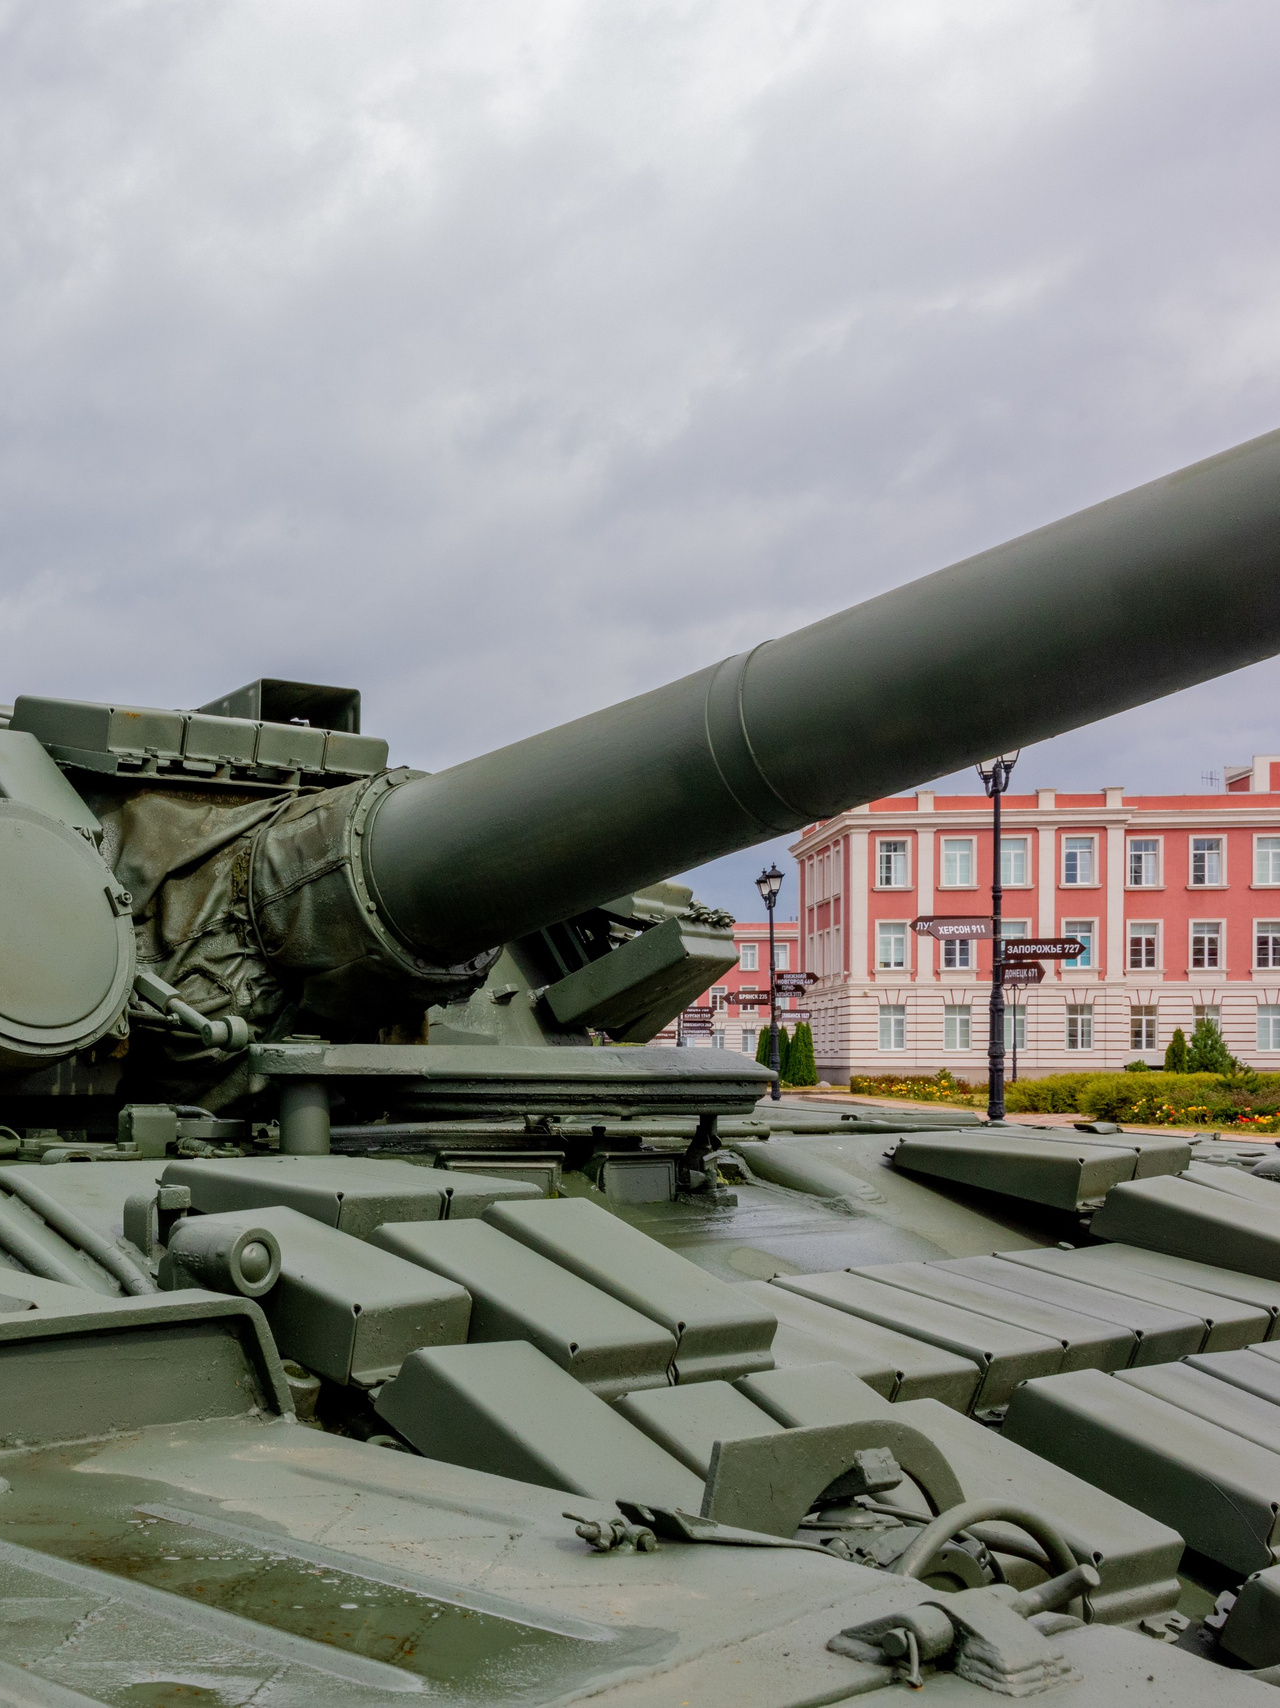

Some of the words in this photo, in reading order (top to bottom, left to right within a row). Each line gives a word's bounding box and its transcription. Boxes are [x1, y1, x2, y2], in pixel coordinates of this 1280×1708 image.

[938, 926, 970, 935] ХЕРСОН
[971, 924, 986, 933] 911
[1007, 944, 1062, 954] ЗАПОРОЖЬЕ
[1064, 944, 1080, 953] 727
[1004, 969, 1028, 980] ДОНЕЦК
[1028, 968, 1038, 978] 671
